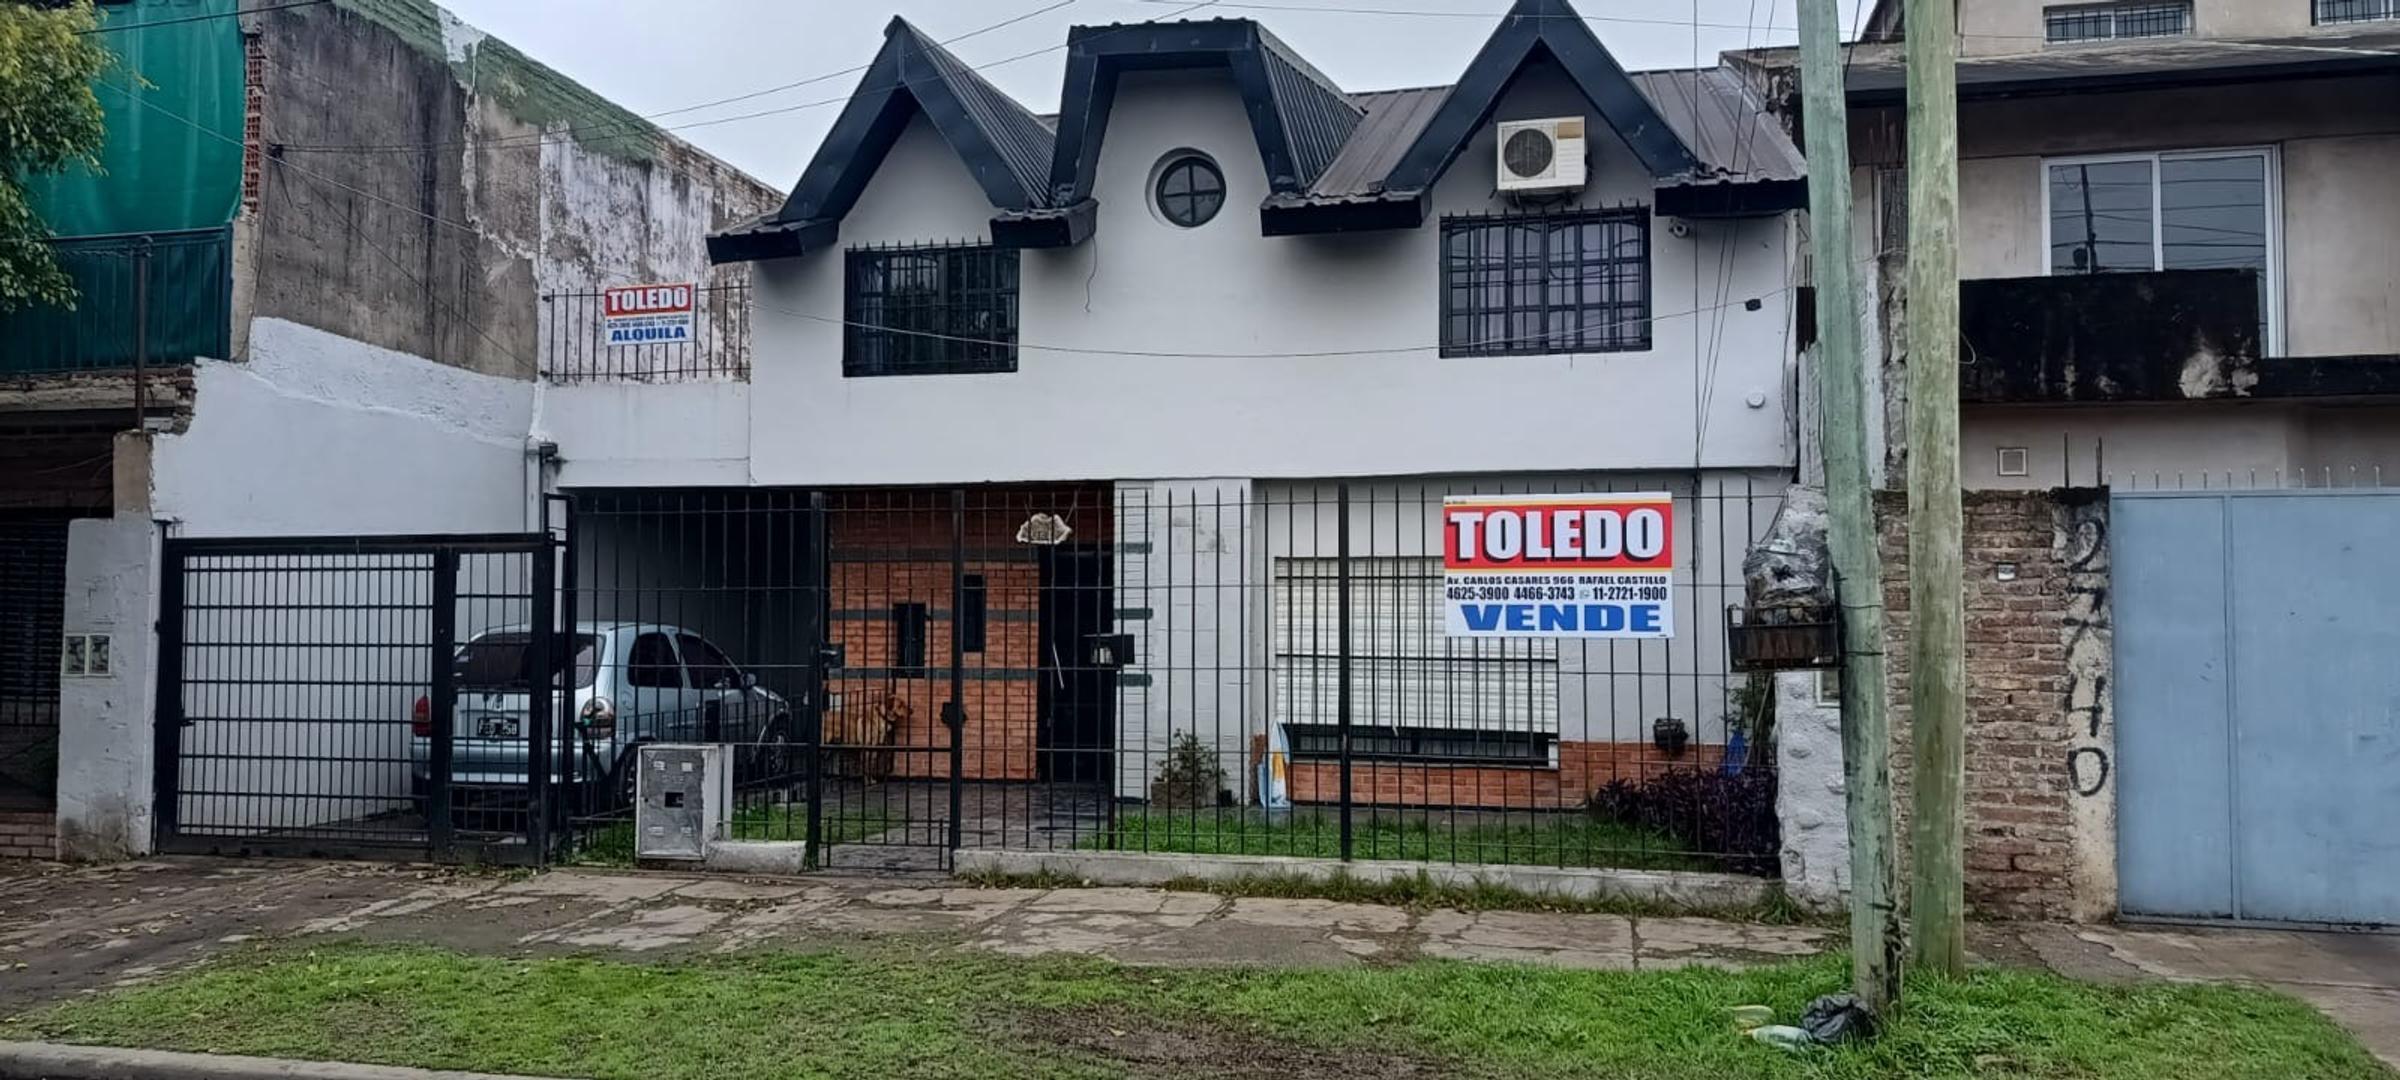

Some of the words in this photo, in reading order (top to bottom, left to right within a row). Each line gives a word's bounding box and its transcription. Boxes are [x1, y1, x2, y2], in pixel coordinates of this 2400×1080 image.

[608, 287, 688, 311] TOLEDO
[612, 326, 686, 341] ALQUILA
[1448, 508, 1664, 561] TOLEDO
[1463, 576, 1502, 584] CARLOS
[1504, 576, 1551, 584] CASARES
[1579, 576, 1615, 584] RAFAEL
[1617, 576, 1667, 584] CASTILLO
[1446, 587, 1509, 600] 4625-3900
[1513, 587, 1575, 600] 4466-3743
[1592, 587, 1667, 600] 11-2721-1900
[1461, 604, 1661, 632] VENDE
